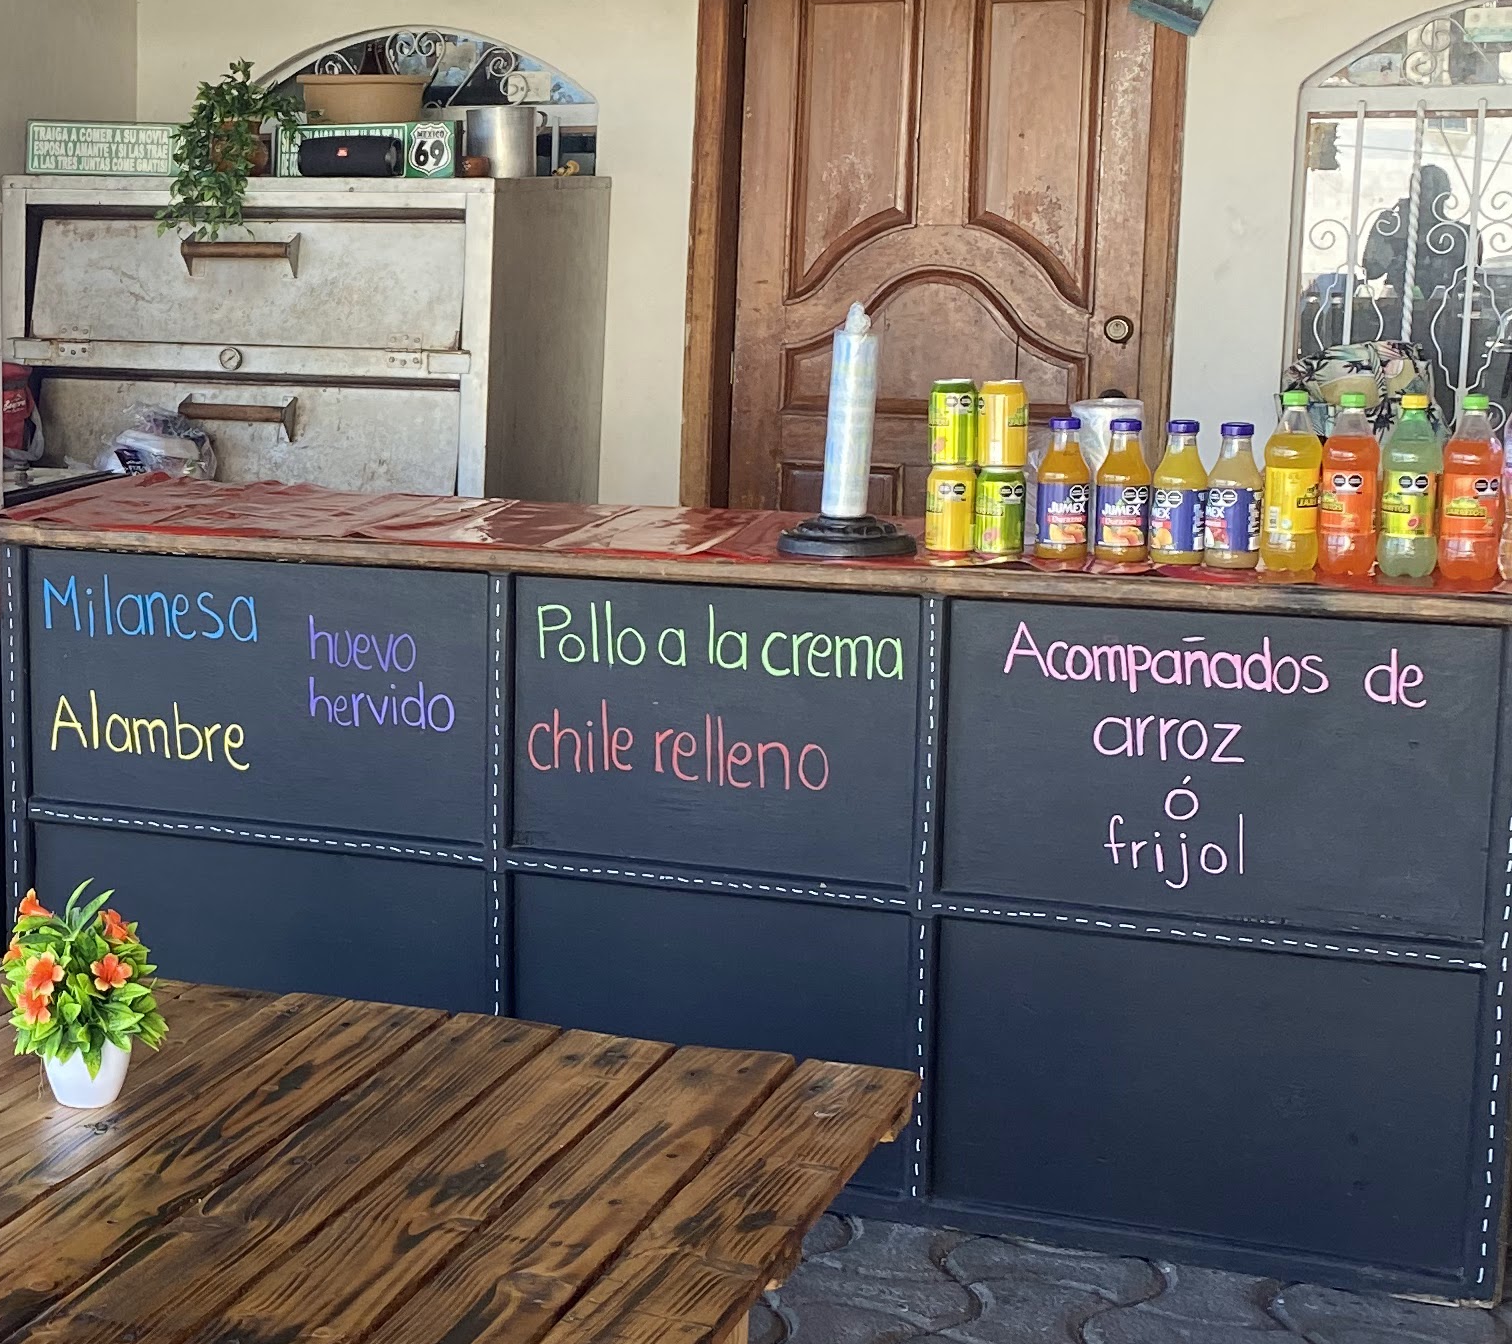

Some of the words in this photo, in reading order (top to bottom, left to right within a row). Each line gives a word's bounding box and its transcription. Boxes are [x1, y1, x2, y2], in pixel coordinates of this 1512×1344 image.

[33, 127, 69, 141] TRAIGA
[70, 128, 78, 141] A
[79, 128, 113, 142] COMER
[114, 129, 123, 143] A
[124, 130, 137, 143] SU
[138, 130, 168, 144] NOVIA
[33, 141, 66, 156] ESPOSA
[67, 142, 74, 156] O
[75, 142, 109, 157] AMANTE
[110, 143, 118, 157] Y
[118, 144, 127, 158] SI
[128, 144, 145, 158] LAS
[146, 144, 168, 158] TRAE
[414, 140, 445, 166] 69
[417, 130, 445, 139] MEXICO
[33, 156, 39, 169] A
[40, 156, 55, 169] LAS
[57, 156, 78, 170] TRES
[79, 157, 111, 171] JUNTAS
[112, 158, 135, 172] COME
[136, 159, 168, 173] GRATIS!
[1048, 501, 1085, 514] JUMEX
[1101, 503, 1140, 516] JUMEX
[43, 574, 258, 643] Milanesa
[309, 614, 417, 673] huevo
[537, 601, 646, 667] Pollo
[658, 628, 686, 666] a
[708, 604, 747, 670] la
[762, 631, 903, 680] crema
[1004, 621, 1329, 694] Acompañados
[1364, 648, 1427, 708] de
[309, 676, 455, 732] hervido
[51, 690, 250, 771] Alambre
[527, 698, 634, 773] chile
[654, 713, 829, 791] relleno
[1093, 716, 1245, 763] arroz
[1164, 775, 1199, 820] ó
[1104, 813, 1244, 889] frijol
